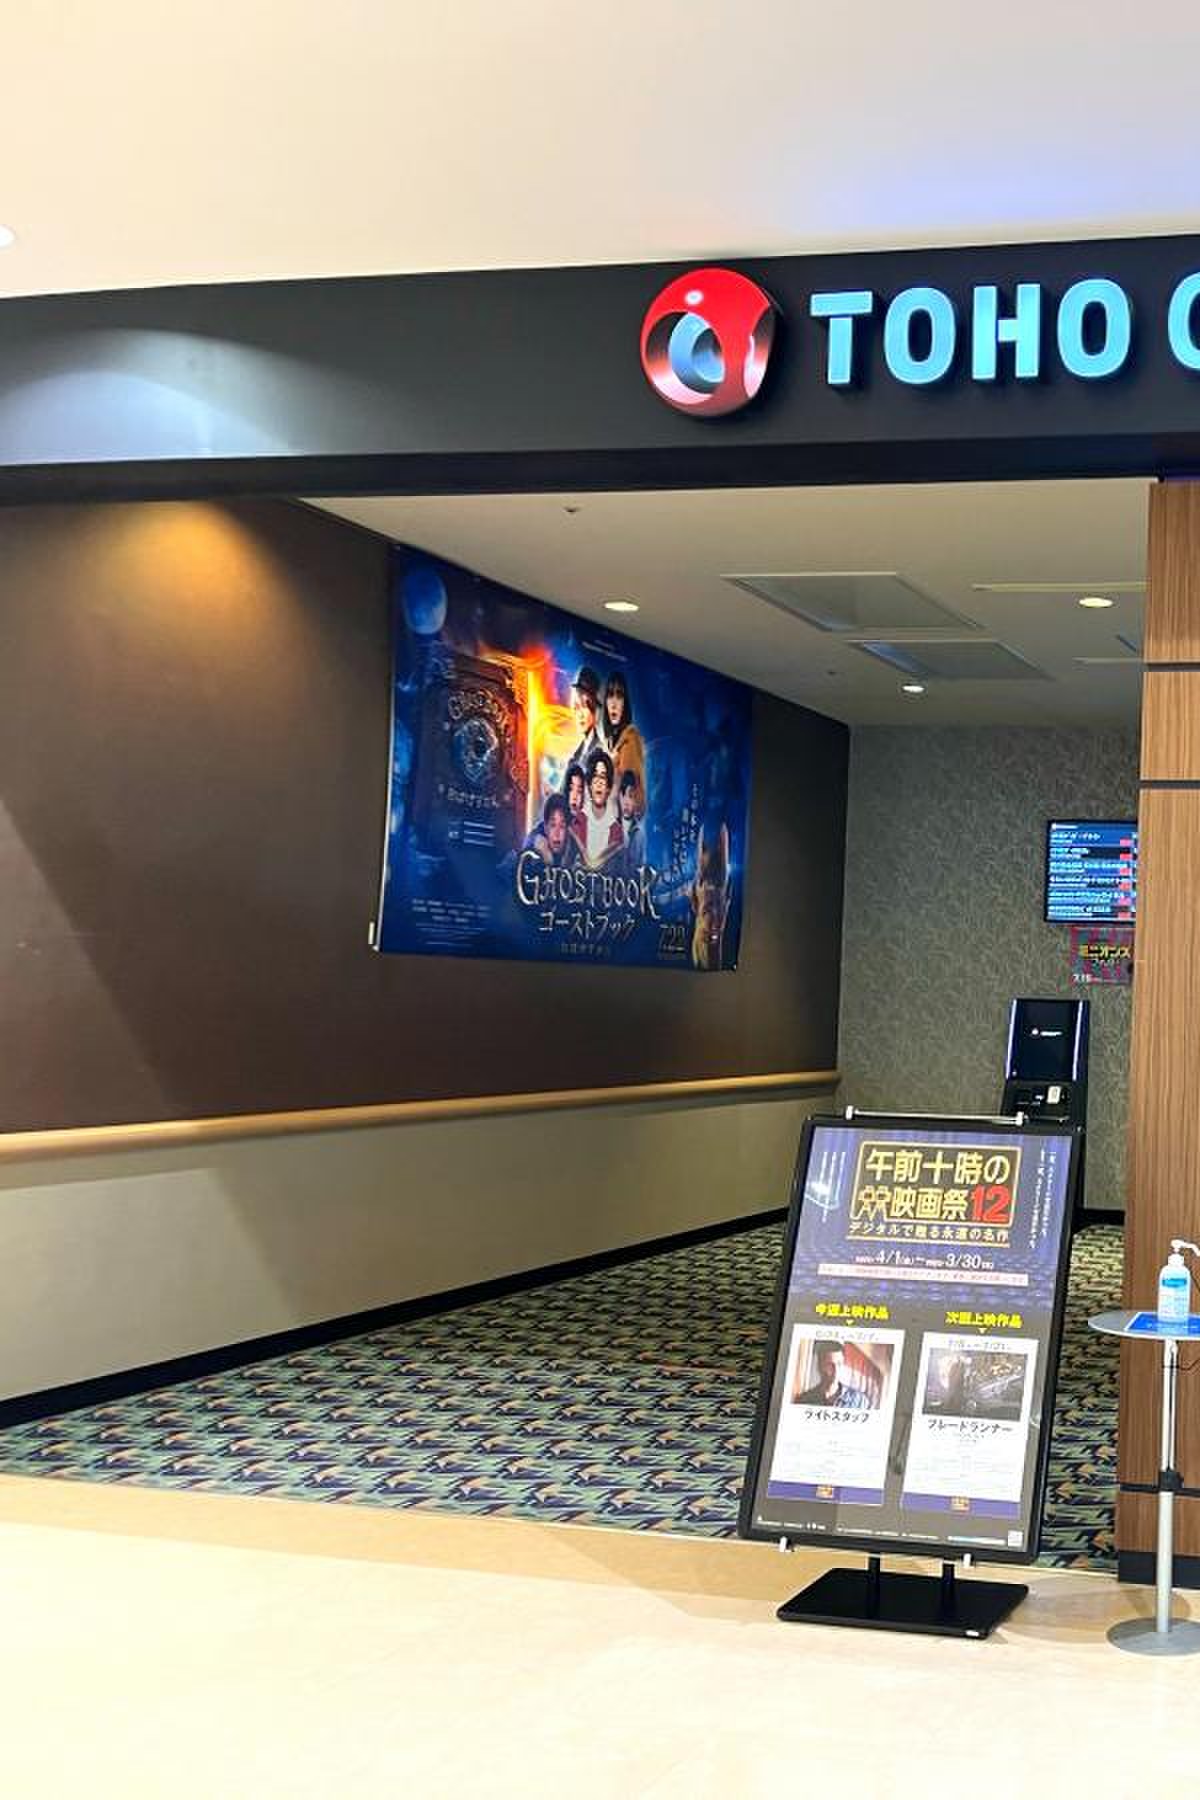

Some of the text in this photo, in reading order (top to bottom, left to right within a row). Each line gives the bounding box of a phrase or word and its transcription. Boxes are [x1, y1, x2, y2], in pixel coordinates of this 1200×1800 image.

[808, 278, 1133, 387] TOHO
[865, 1148, 1011, 1186] 午前十時の
